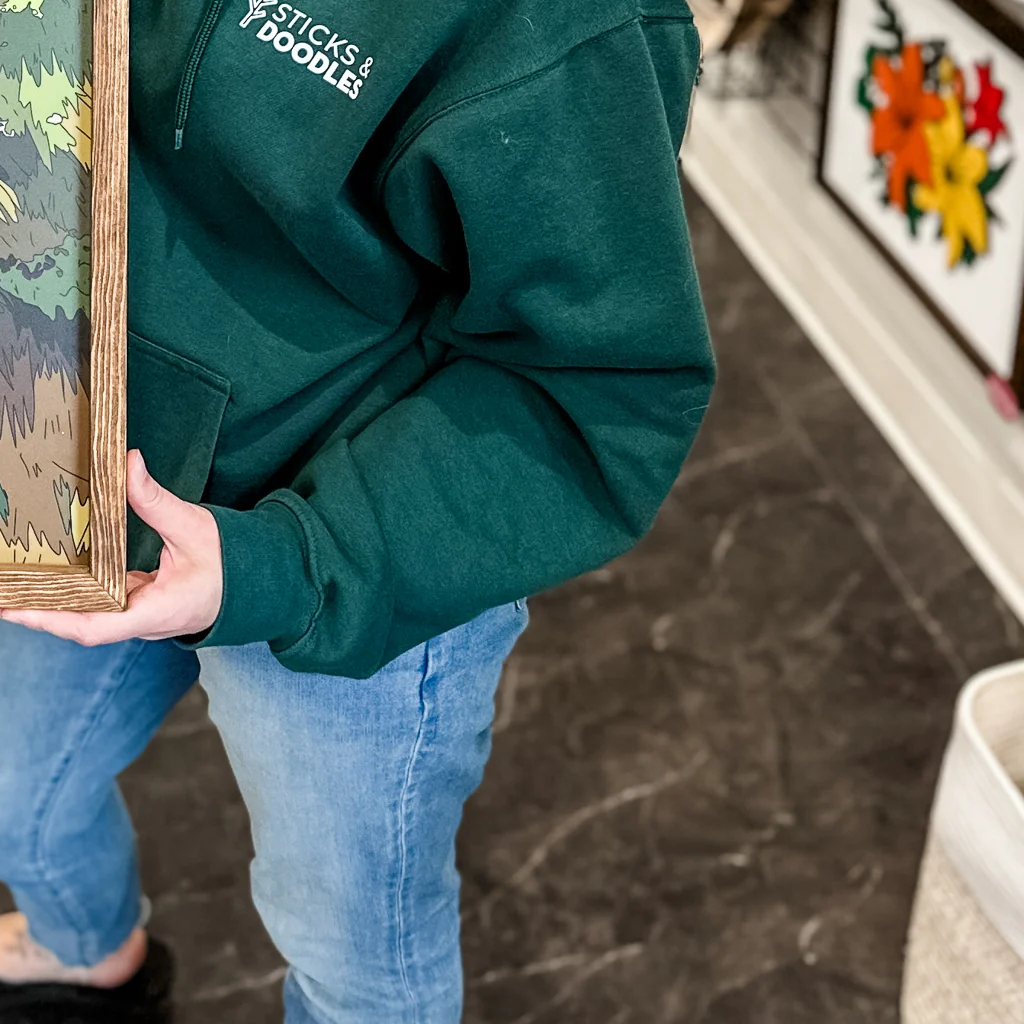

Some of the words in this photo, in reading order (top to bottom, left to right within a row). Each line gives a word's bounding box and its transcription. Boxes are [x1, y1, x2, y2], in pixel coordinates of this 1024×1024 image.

[256, 20, 363, 100] DOODLES
[272, 3, 360, 66] STICKS
[359, 57, 373, 79] &
